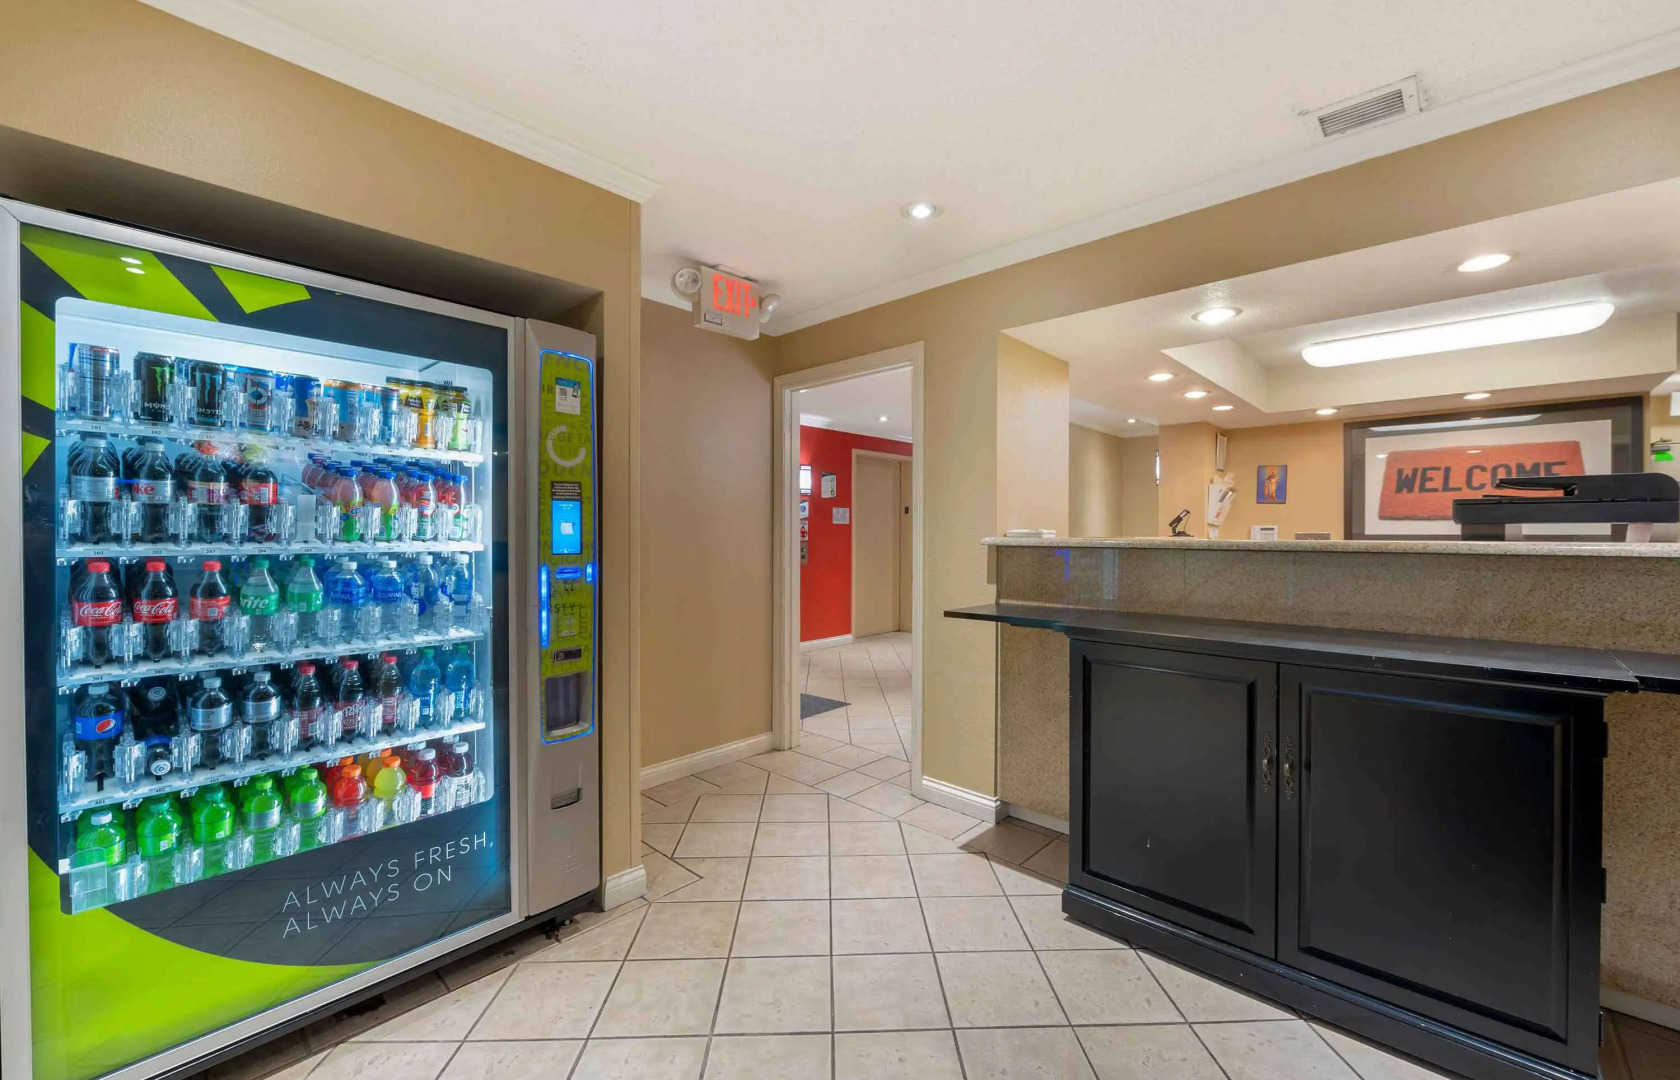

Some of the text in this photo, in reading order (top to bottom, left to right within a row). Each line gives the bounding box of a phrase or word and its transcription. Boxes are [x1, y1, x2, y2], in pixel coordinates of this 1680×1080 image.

[713, 274, 753, 319] EXIT
[134, 600, 176, 615] Coca-Cola
[282, 831, 494, 913] ALWAYS FRESH,
[283, 865, 451, 939] ALWAYS ON
